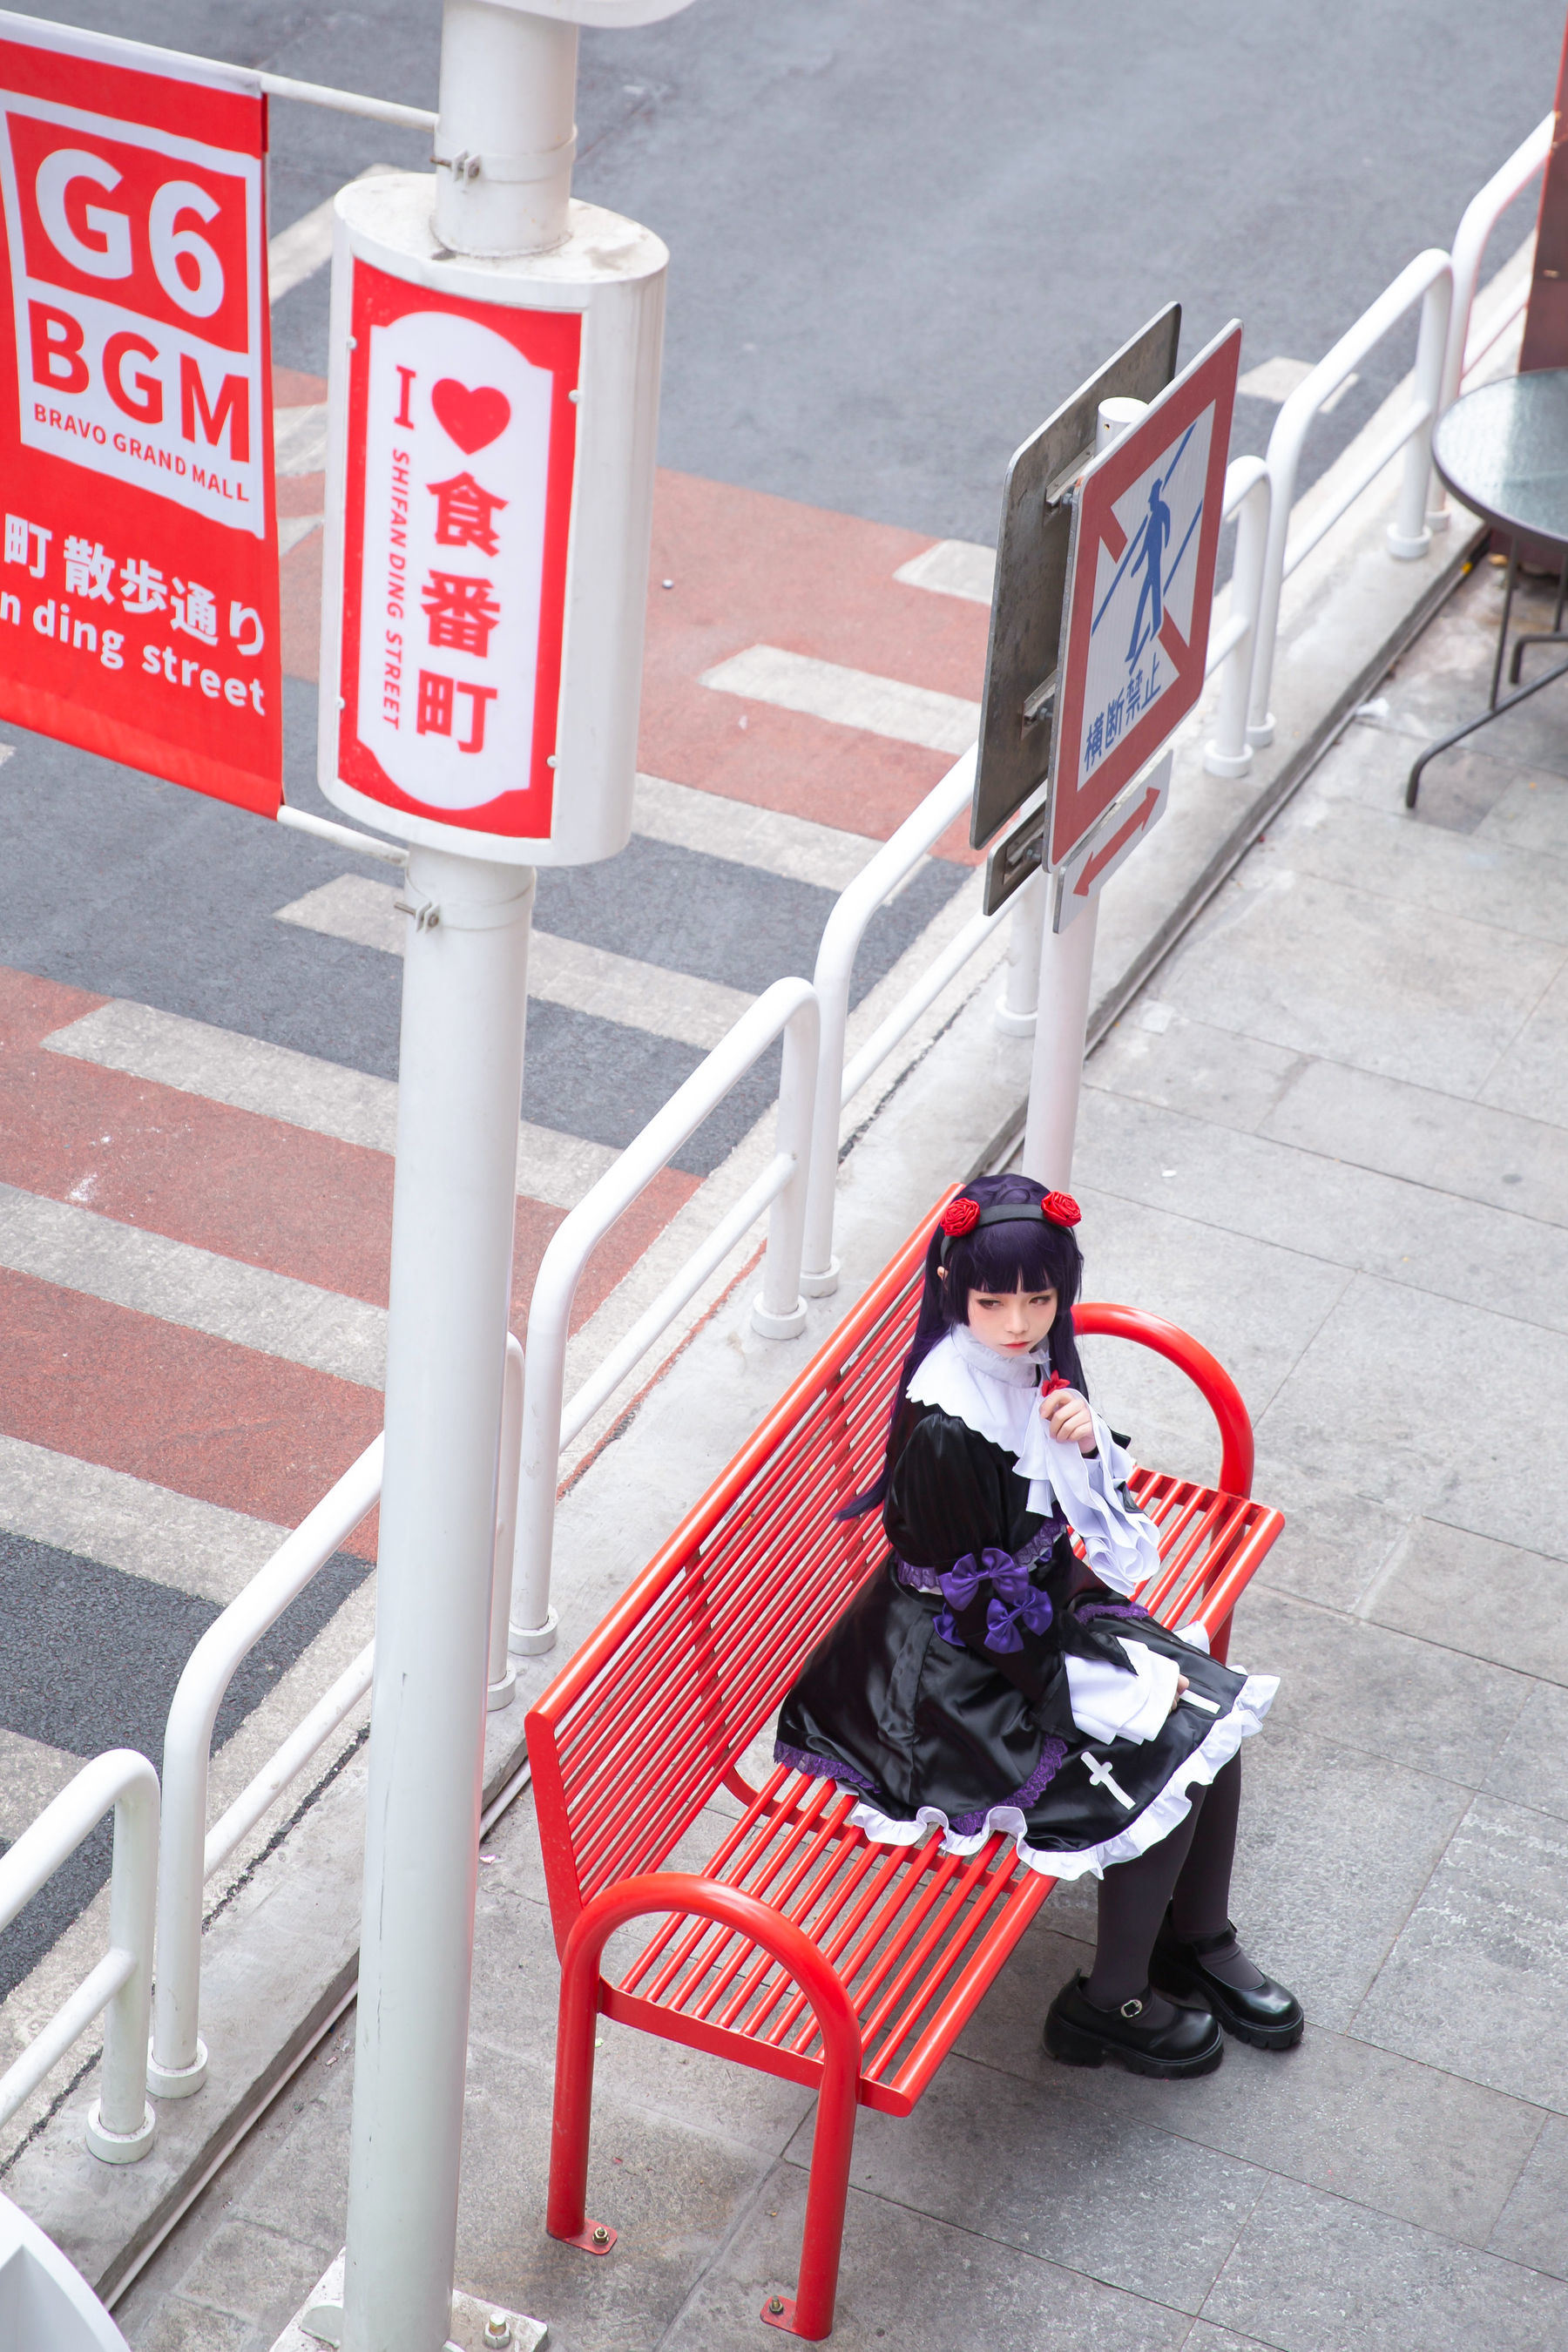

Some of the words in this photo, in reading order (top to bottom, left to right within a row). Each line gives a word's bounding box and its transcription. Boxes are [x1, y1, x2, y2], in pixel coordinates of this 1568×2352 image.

[35, 148, 225, 318] G6
[28, 299, 249, 463] BGM
[33, 402, 107, 446] BRAVO
[112, 432, 187, 476] GRAND
[192, 463, 250, 503] MALL
[394, 364, 416, 430] I
[416, 470, 510, 754] 食番町
[32, 598, 125, 671] ding
[141, 645, 266, 716] street
[382, 629, 403, 731] STREET
[1084, 652, 1162, 773] 横断禁止
